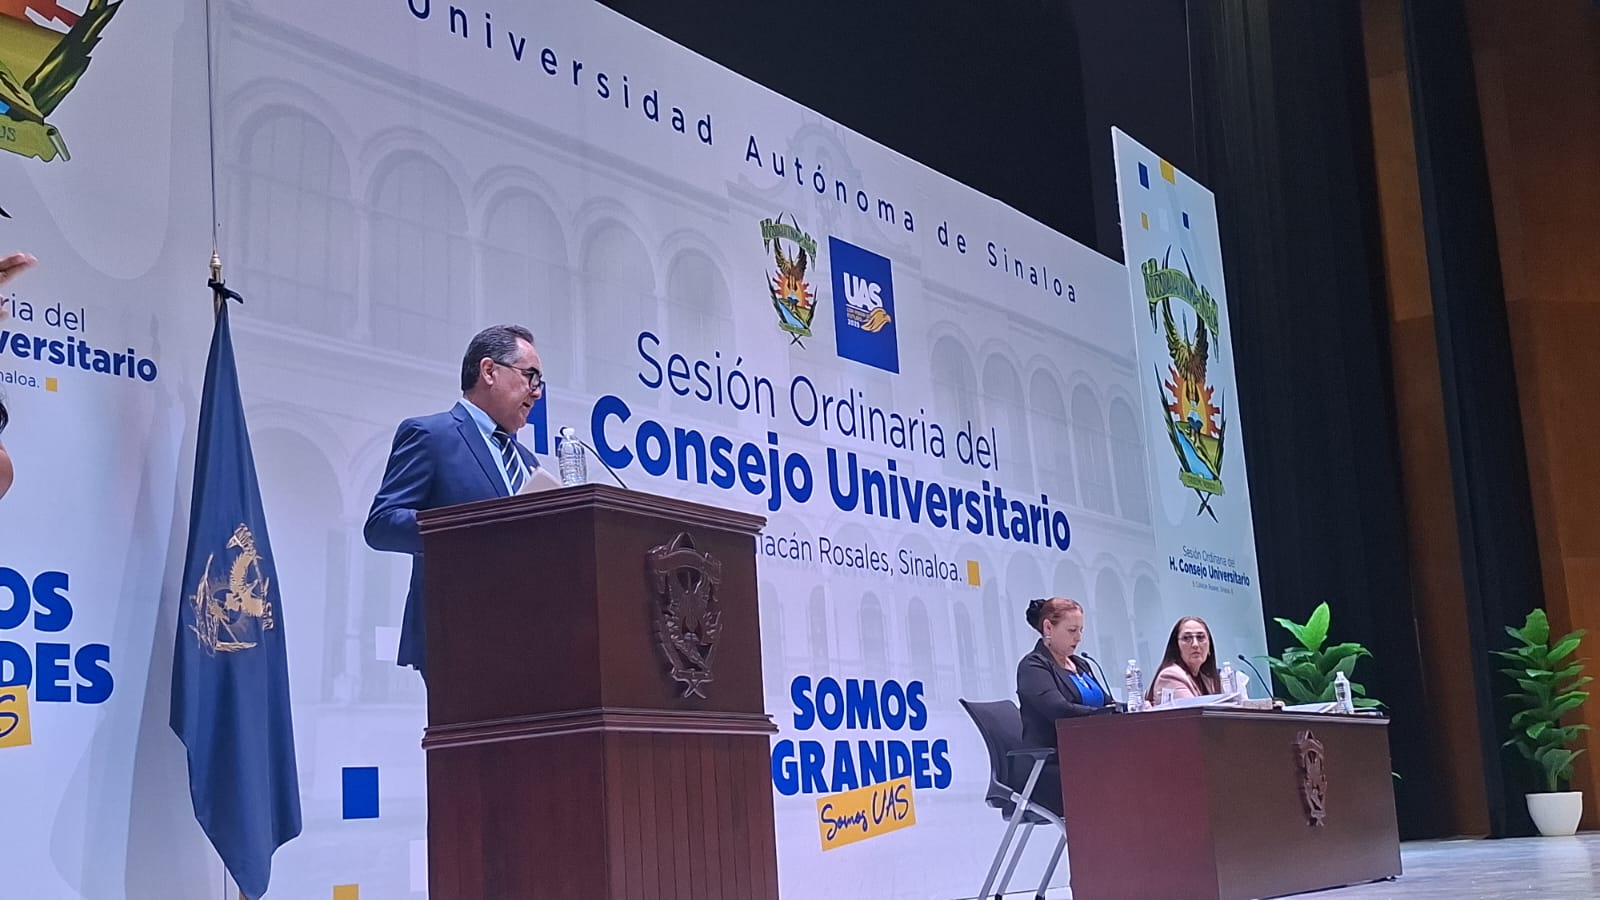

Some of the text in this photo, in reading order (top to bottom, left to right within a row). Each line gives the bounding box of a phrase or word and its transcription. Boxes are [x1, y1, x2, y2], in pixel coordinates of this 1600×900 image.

[745, 135, 915, 233] Autónoma
[937, 221, 968, 254] de
[987, 241, 1077, 304] Sinaloa
[45, 302, 85, 333] del
[843, 271, 883, 311] UAS
[637, 331, 999, 471] Sesión Ordinaria del
[591, 395, 813, 512] Consejo
[826, 448, 1071, 552] Universitario
[818, 536, 894, 577] Rosales,
[898, 549, 963, 583] Sinaloa.
[1168, 555, 1250, 586] H. Consejo Universitario
[790, 675, 928, 731] SOMOS
[771, 738, 953, 796] GRANDES
[820, 784, 909, 841] Somos UAS
